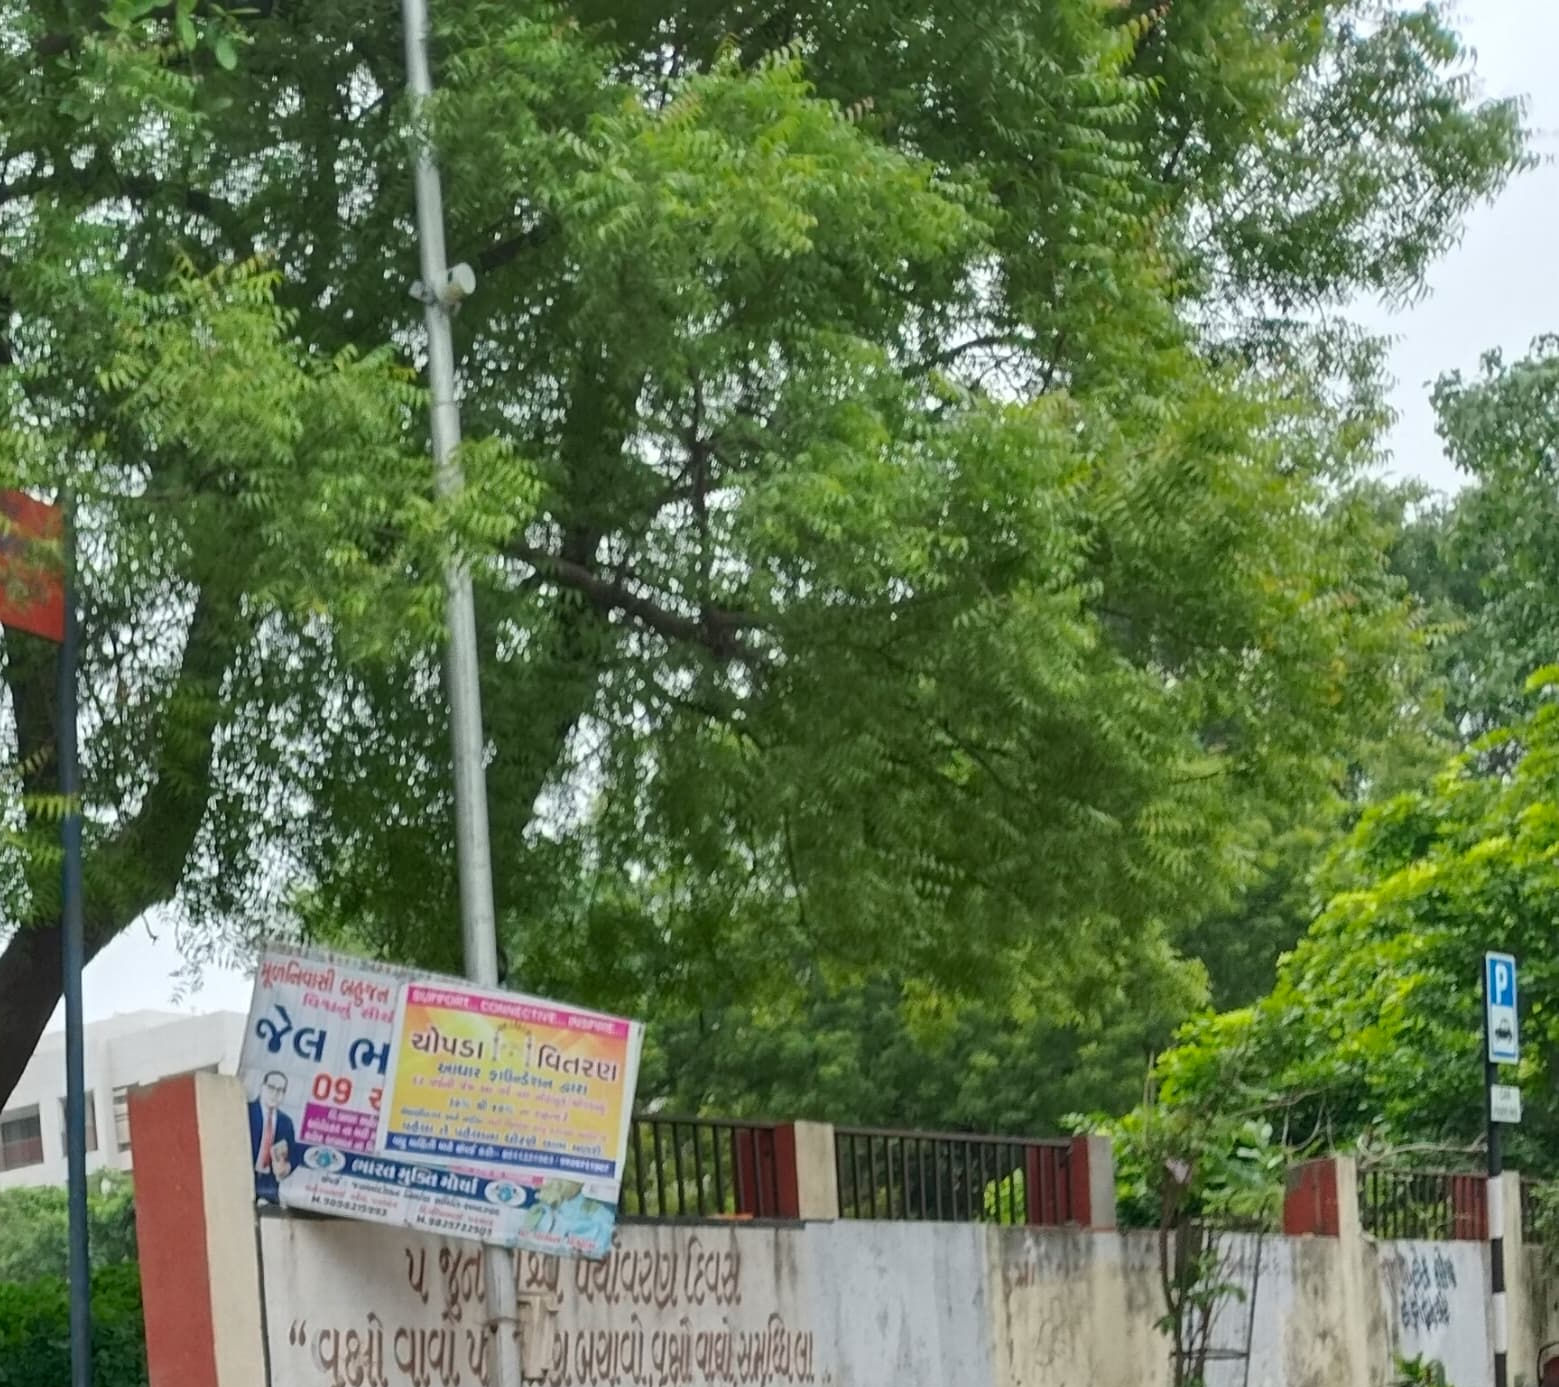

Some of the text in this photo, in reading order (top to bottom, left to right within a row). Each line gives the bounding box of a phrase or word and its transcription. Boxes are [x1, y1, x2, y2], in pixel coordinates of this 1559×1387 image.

[1494, 964, 1509, 1005] P
[255, 1003, 390, 1075] જેલ ભ
[411, 1026, 618, 1082] ચોપડા વિતરણ
[313, 1072, 353, 1105] 09
[351, 1158, 396, 1180] ભારત
[683, 1233, 743, 1307] દિવસ
